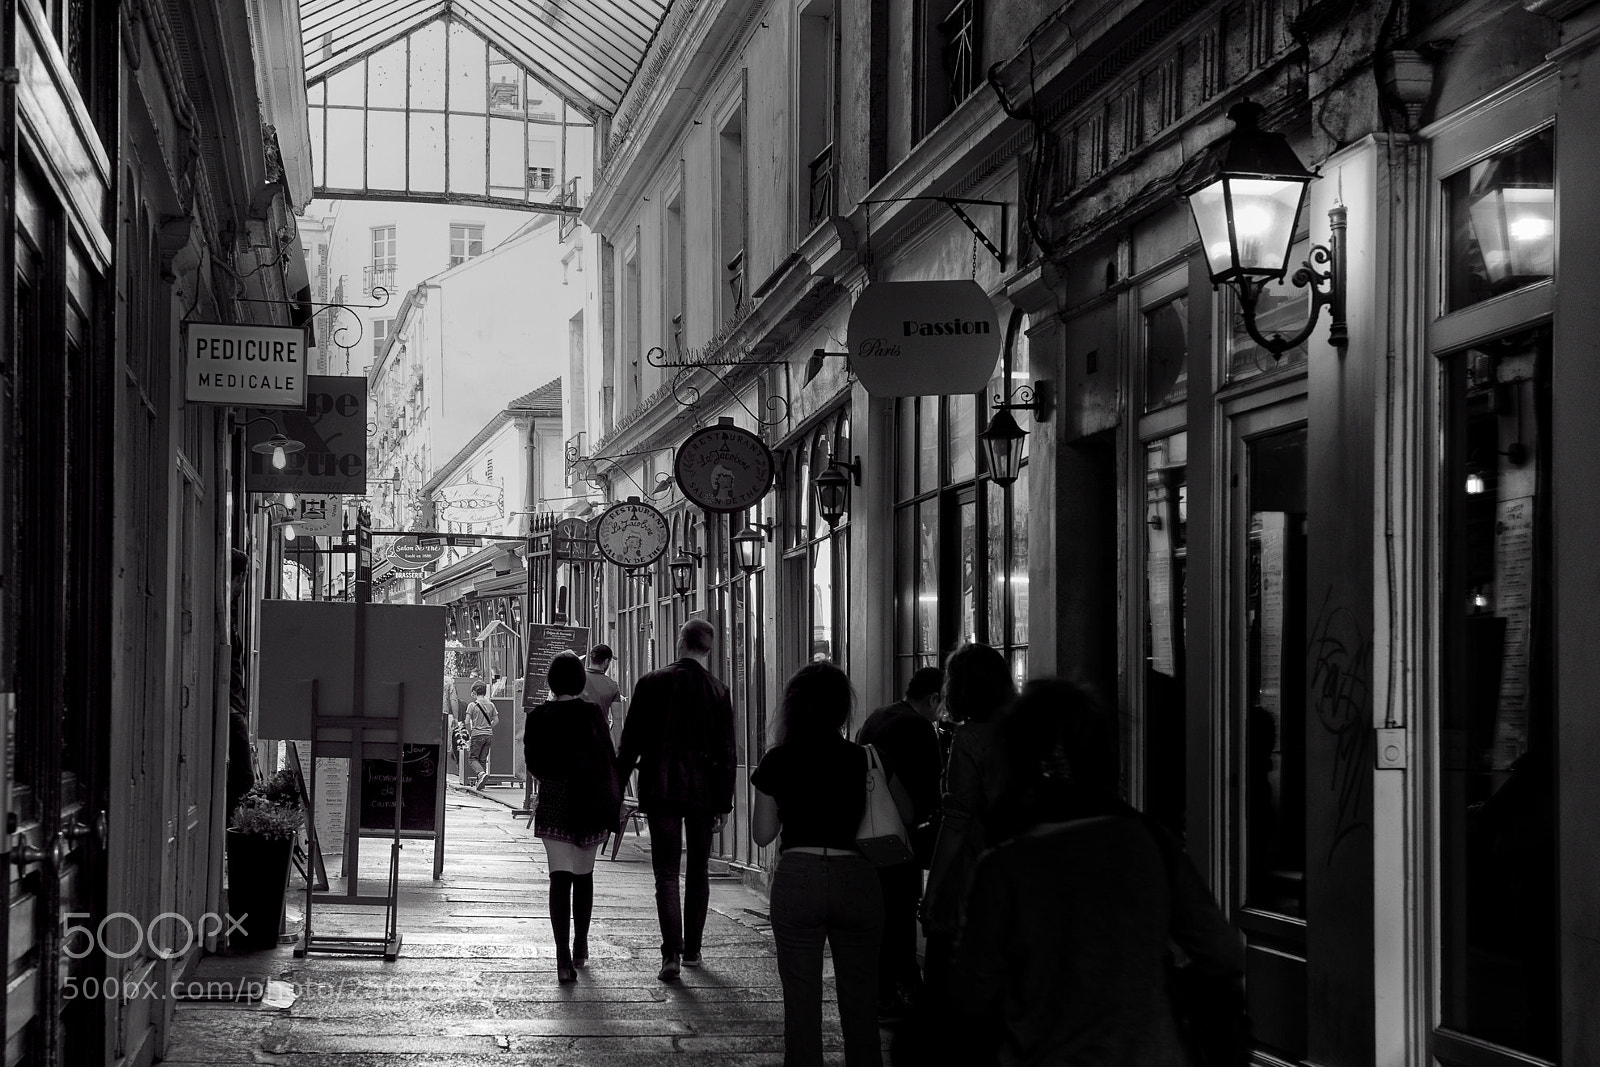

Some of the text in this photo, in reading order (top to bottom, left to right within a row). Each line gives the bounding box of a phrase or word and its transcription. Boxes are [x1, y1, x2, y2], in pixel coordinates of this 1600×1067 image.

[903, 318, 990, 337] Passion
[196, 337, 298, 364] PEDICURE
[858, 337, 901, 358] Paris
[198, 372, 295, 391] MEDICALE
[691, 431, 764, 458] RESTAURANT
[687, 481, 722, 505] SALN
[608, 505, 665, 530] RESTAURANT
[602, 543, 631, 564] SALN
[395, 571, 424, 579] BRASSERIE
